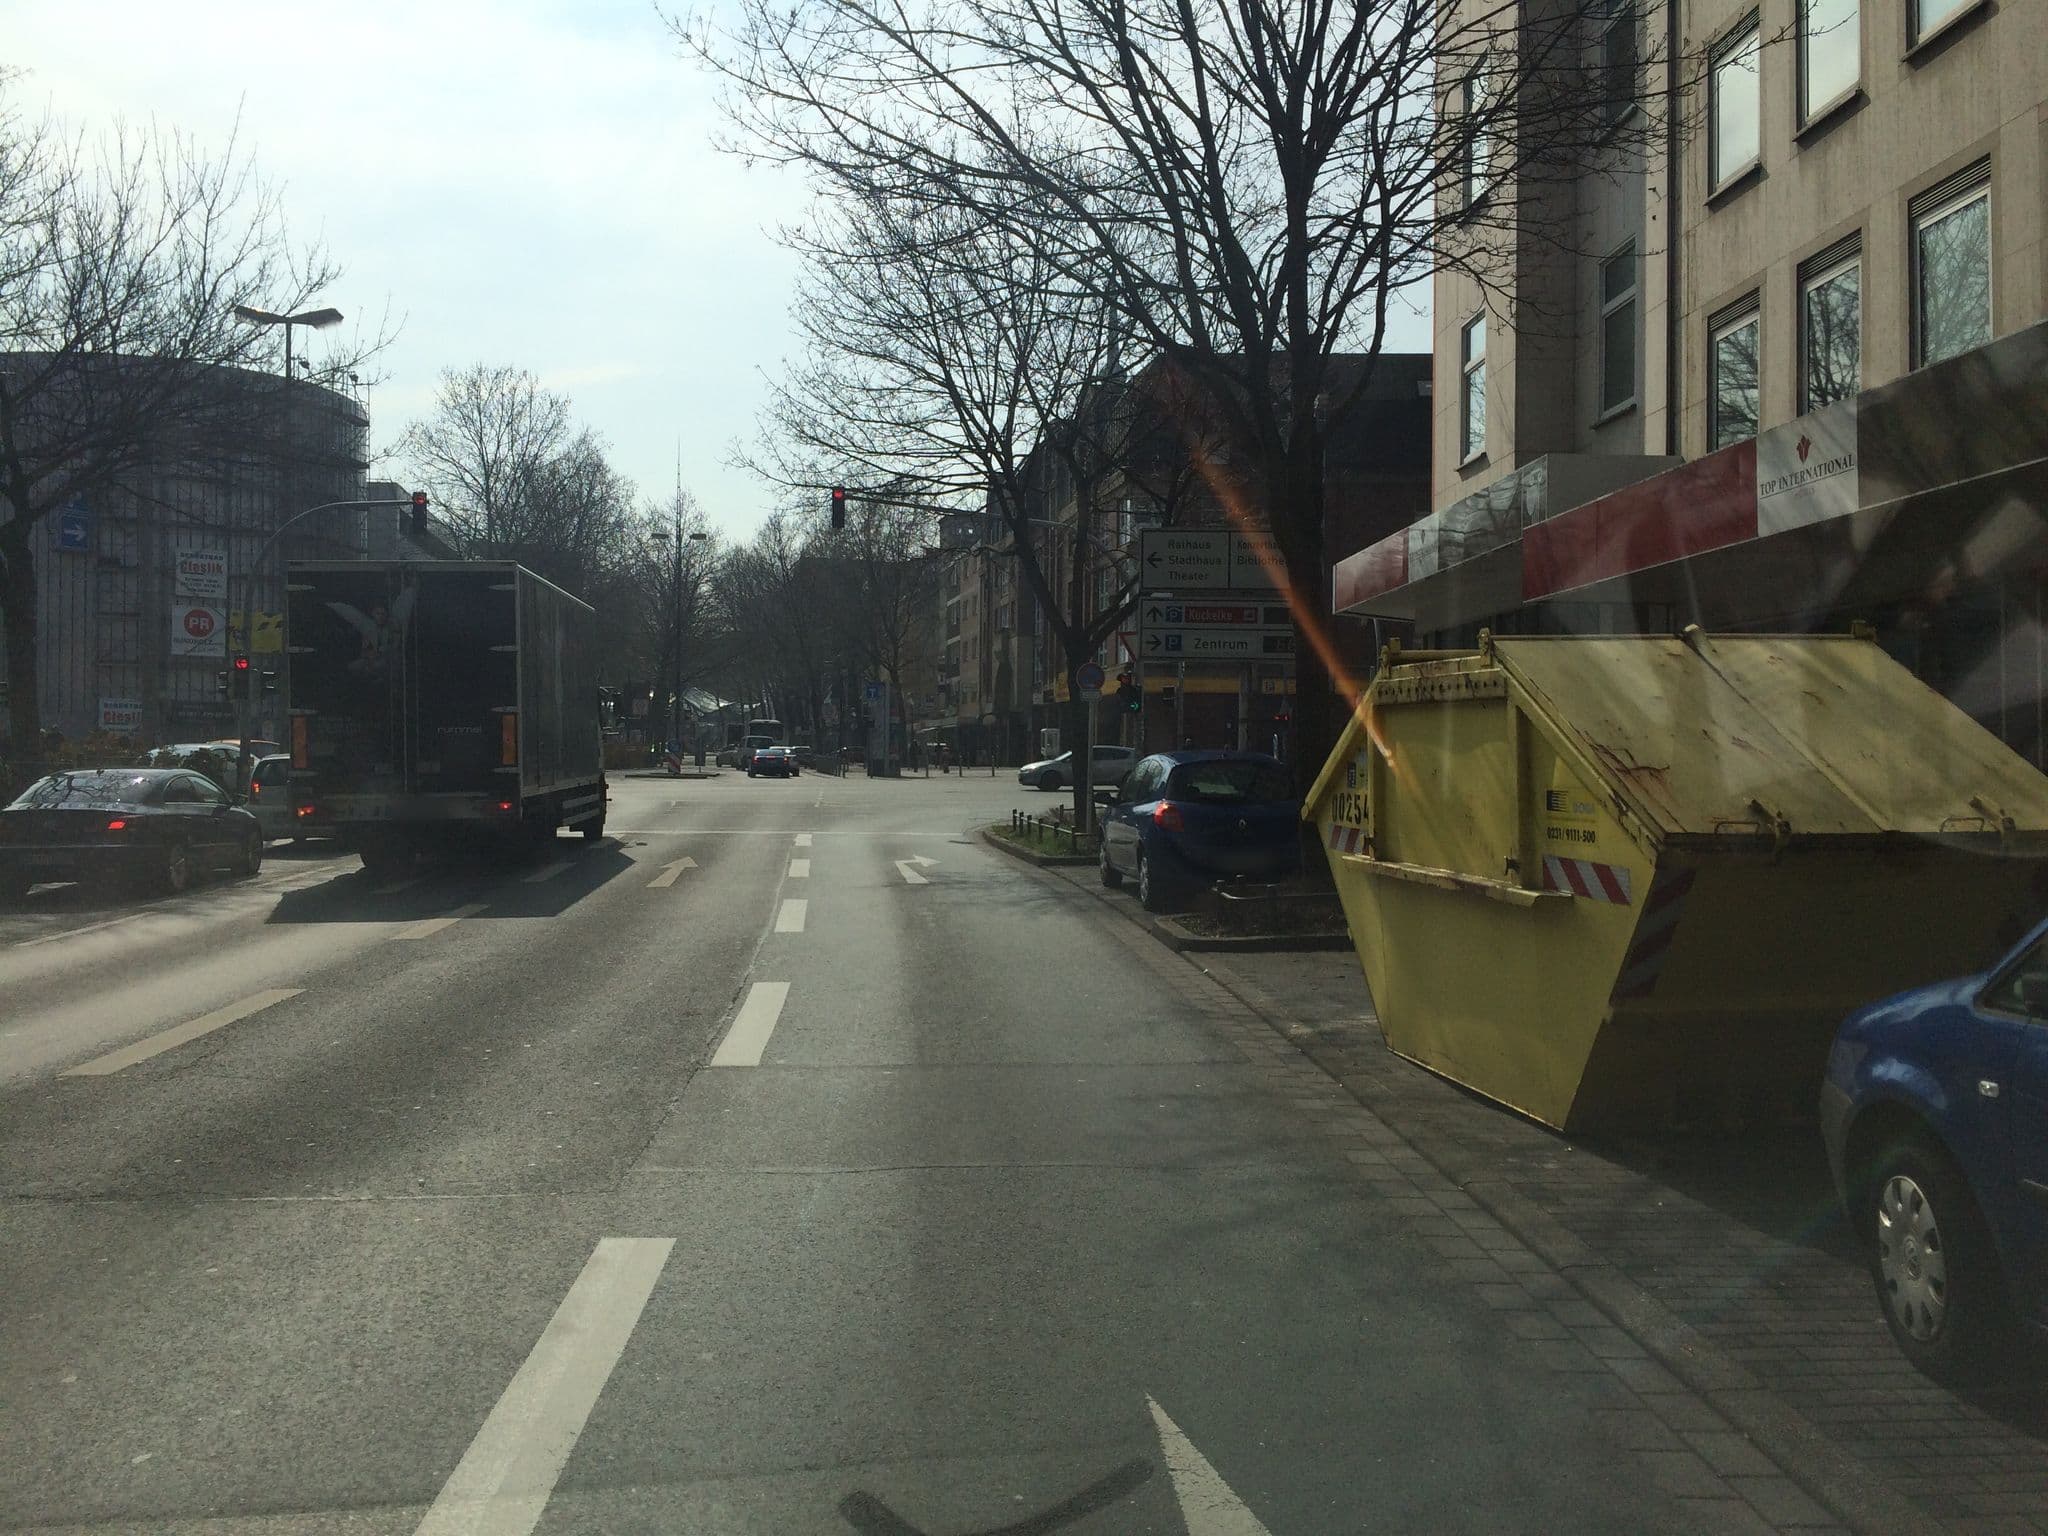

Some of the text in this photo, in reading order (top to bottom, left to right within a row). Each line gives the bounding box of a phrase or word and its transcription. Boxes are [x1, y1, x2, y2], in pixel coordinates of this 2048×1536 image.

[1760, 480, 1777, 496] TOP
[1779, 454, 1855, 490] INTERNATIONAL
[1167, 539, 1211, 550] Rathaus
[1167, 555, 1222, 566] Stadthaus
[1168, 570, 1209, 581] Theater
[190, 616, 210, 630] PR
[1193, 637, 1249, 650] Zentrum
